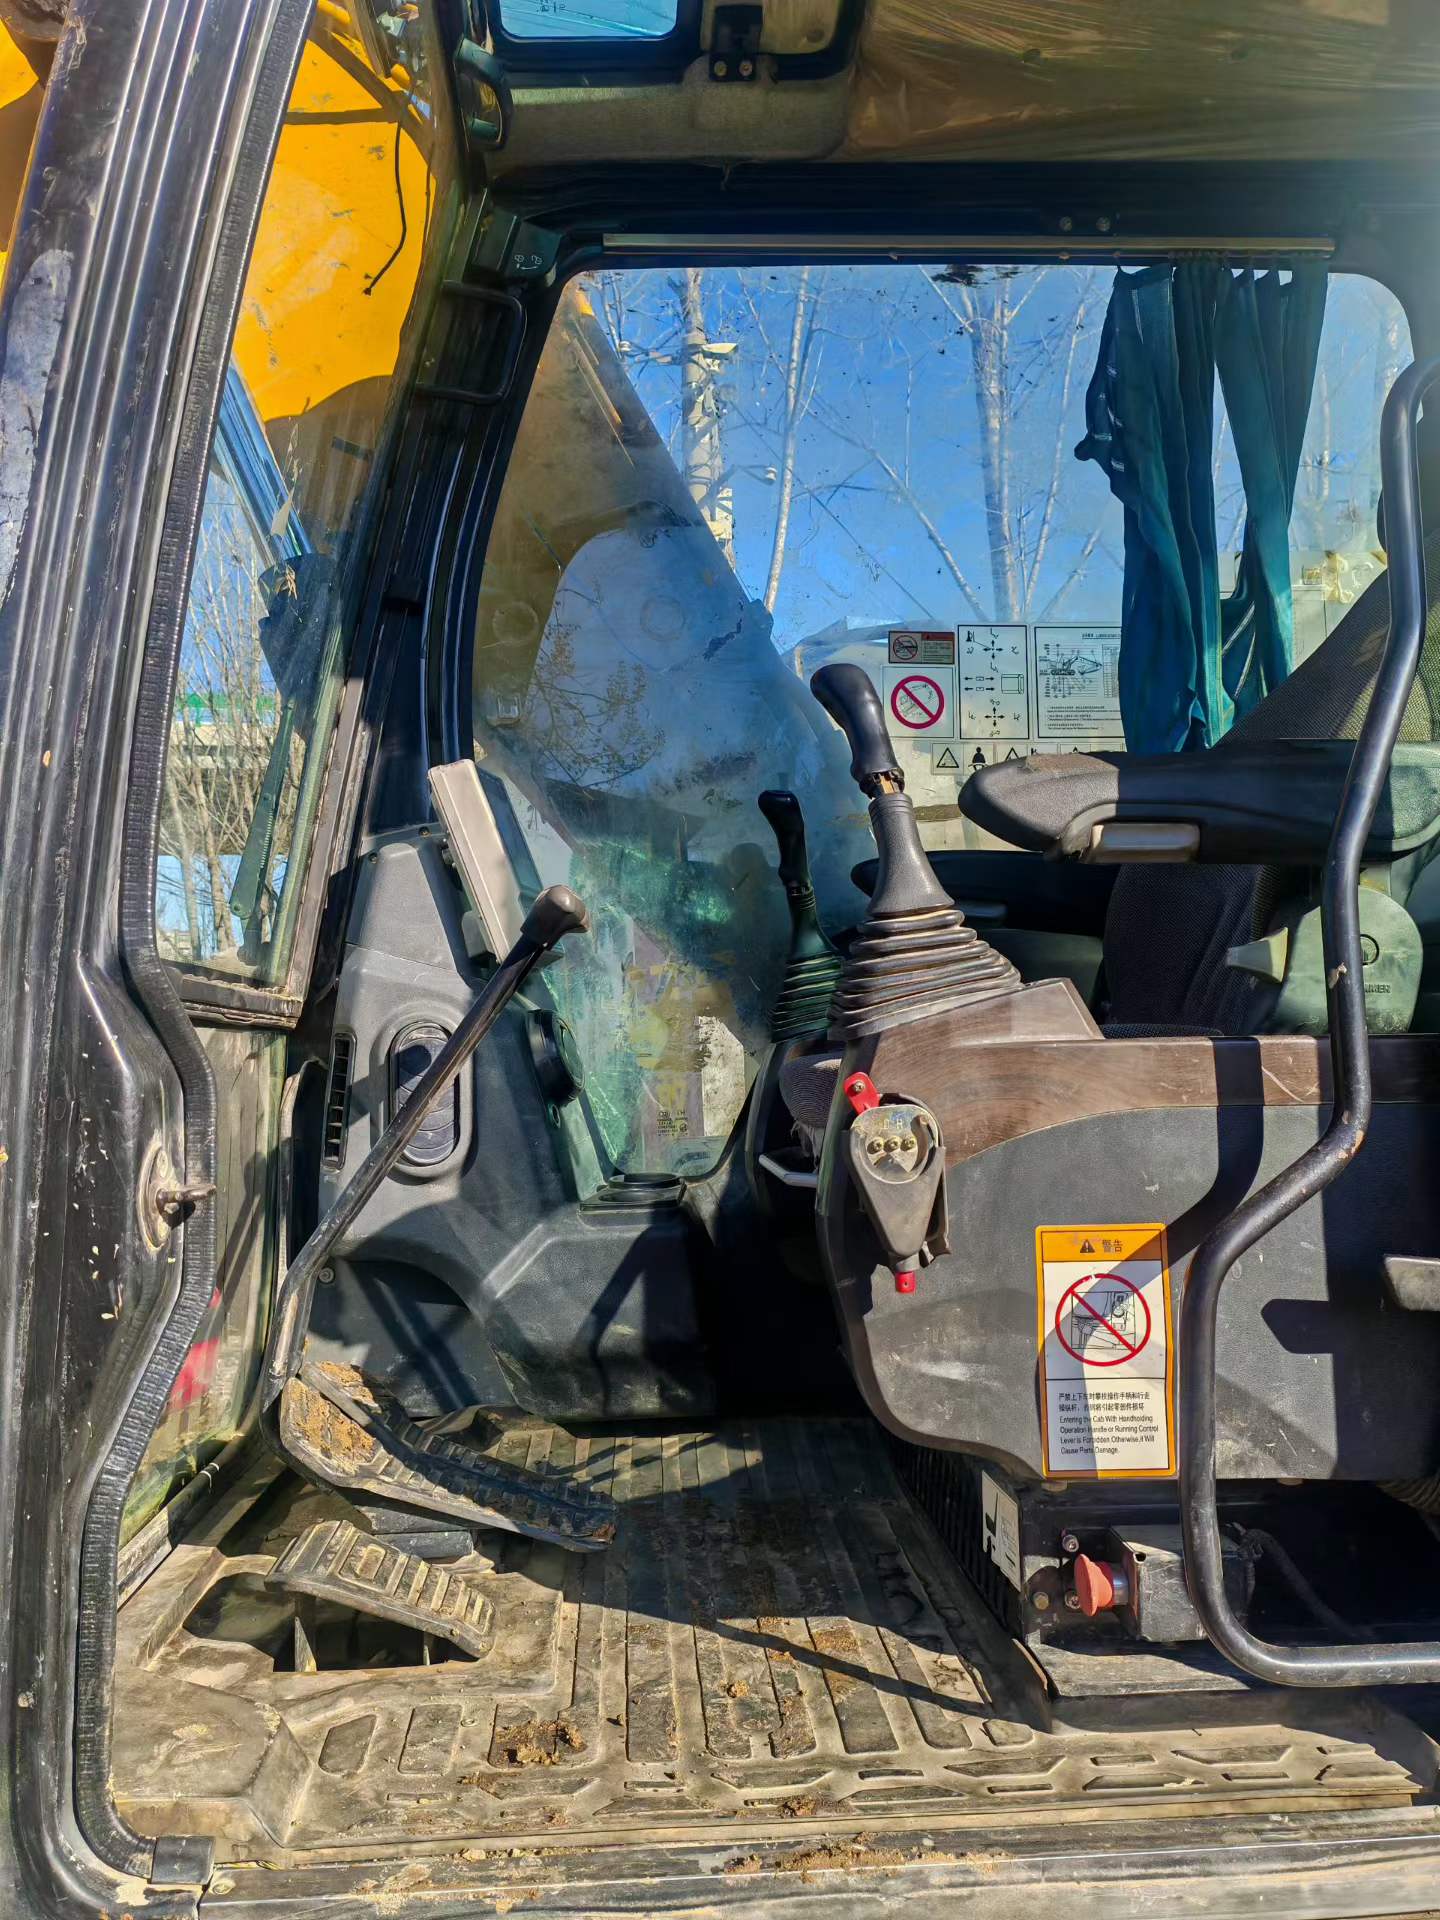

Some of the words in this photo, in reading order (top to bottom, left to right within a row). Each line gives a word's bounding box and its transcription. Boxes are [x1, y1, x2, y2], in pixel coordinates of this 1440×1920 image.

[1102, 1239, 1123, 1253] 警告
[1059, 1415, 1082, 1424] Entering
[1118, 1414, 1153, 1423] Handholding
[1059, 1425, 1086, 1434] Operation
[1114, 1425, 1137, 1434] Running
[1138, 1424, 1158, 1432] Control
[1060, 1436, 1075, 1444] Lever
[1144, 1434, 1155, 1442] Will
[1060, 1446, 1078, 1454] Cause
[1079, 1445, 1094, 1453] Parts
